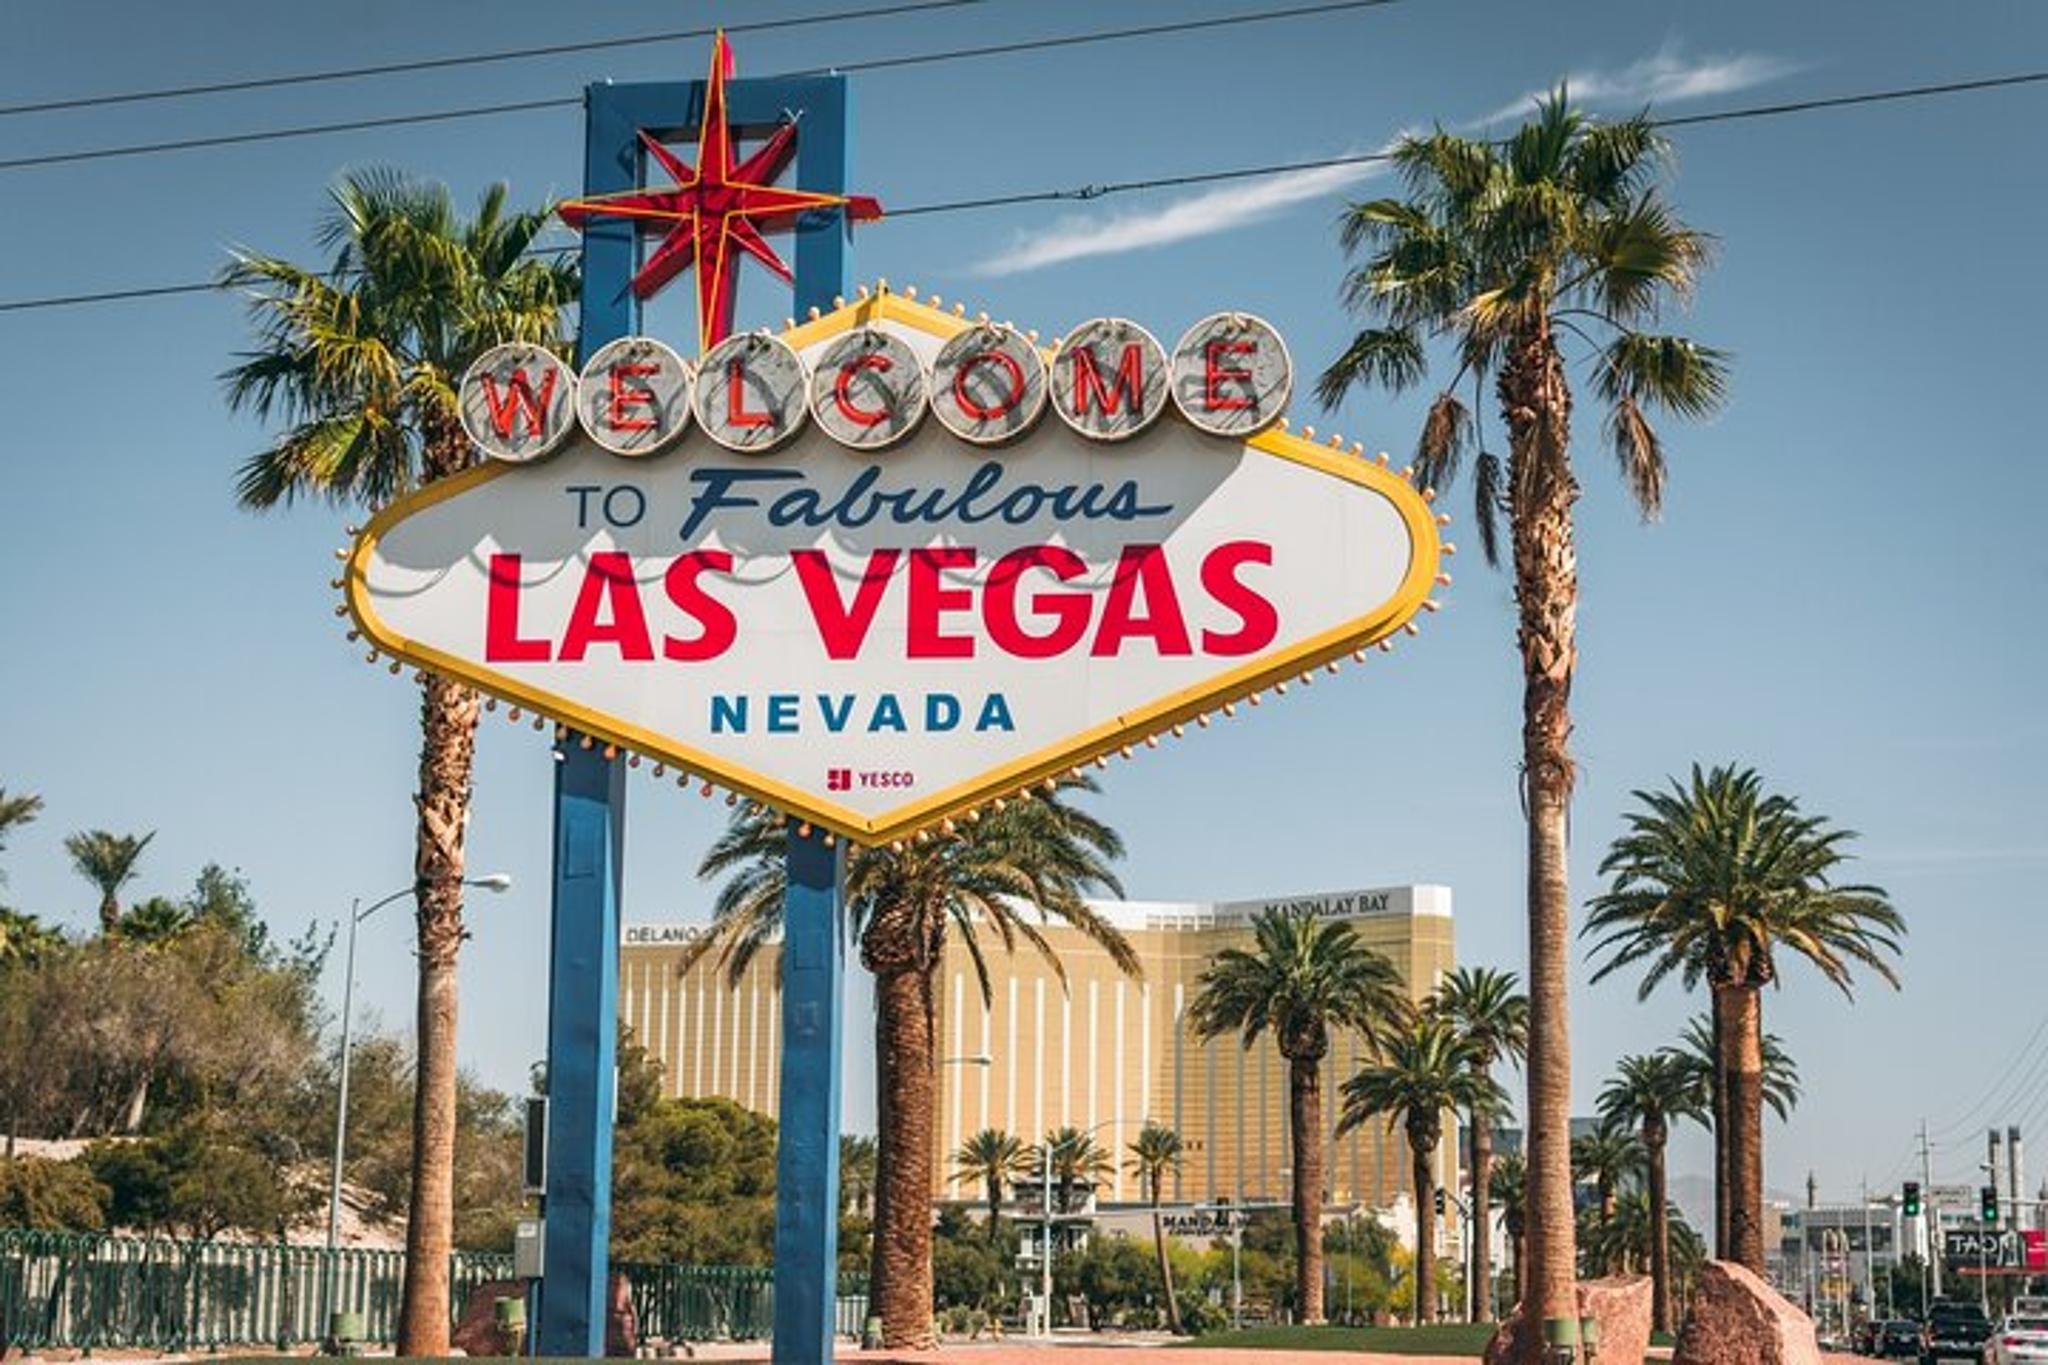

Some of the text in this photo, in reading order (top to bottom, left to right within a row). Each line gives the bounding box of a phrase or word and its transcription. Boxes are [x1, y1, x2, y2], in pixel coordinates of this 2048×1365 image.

[480, 338, 1257, 439] WELCOME
[566, 460, 1175, 542] TO Fabulous
[485, 540, 1281, 664] LAS VEGAS
[709, 692, 1016, 734] NEVADA
[858, 771, 914, 788] YESCO
[1263, 894, 1389, 918] MANDALAY BAY
[626, 926, 699, 942] DELANO
